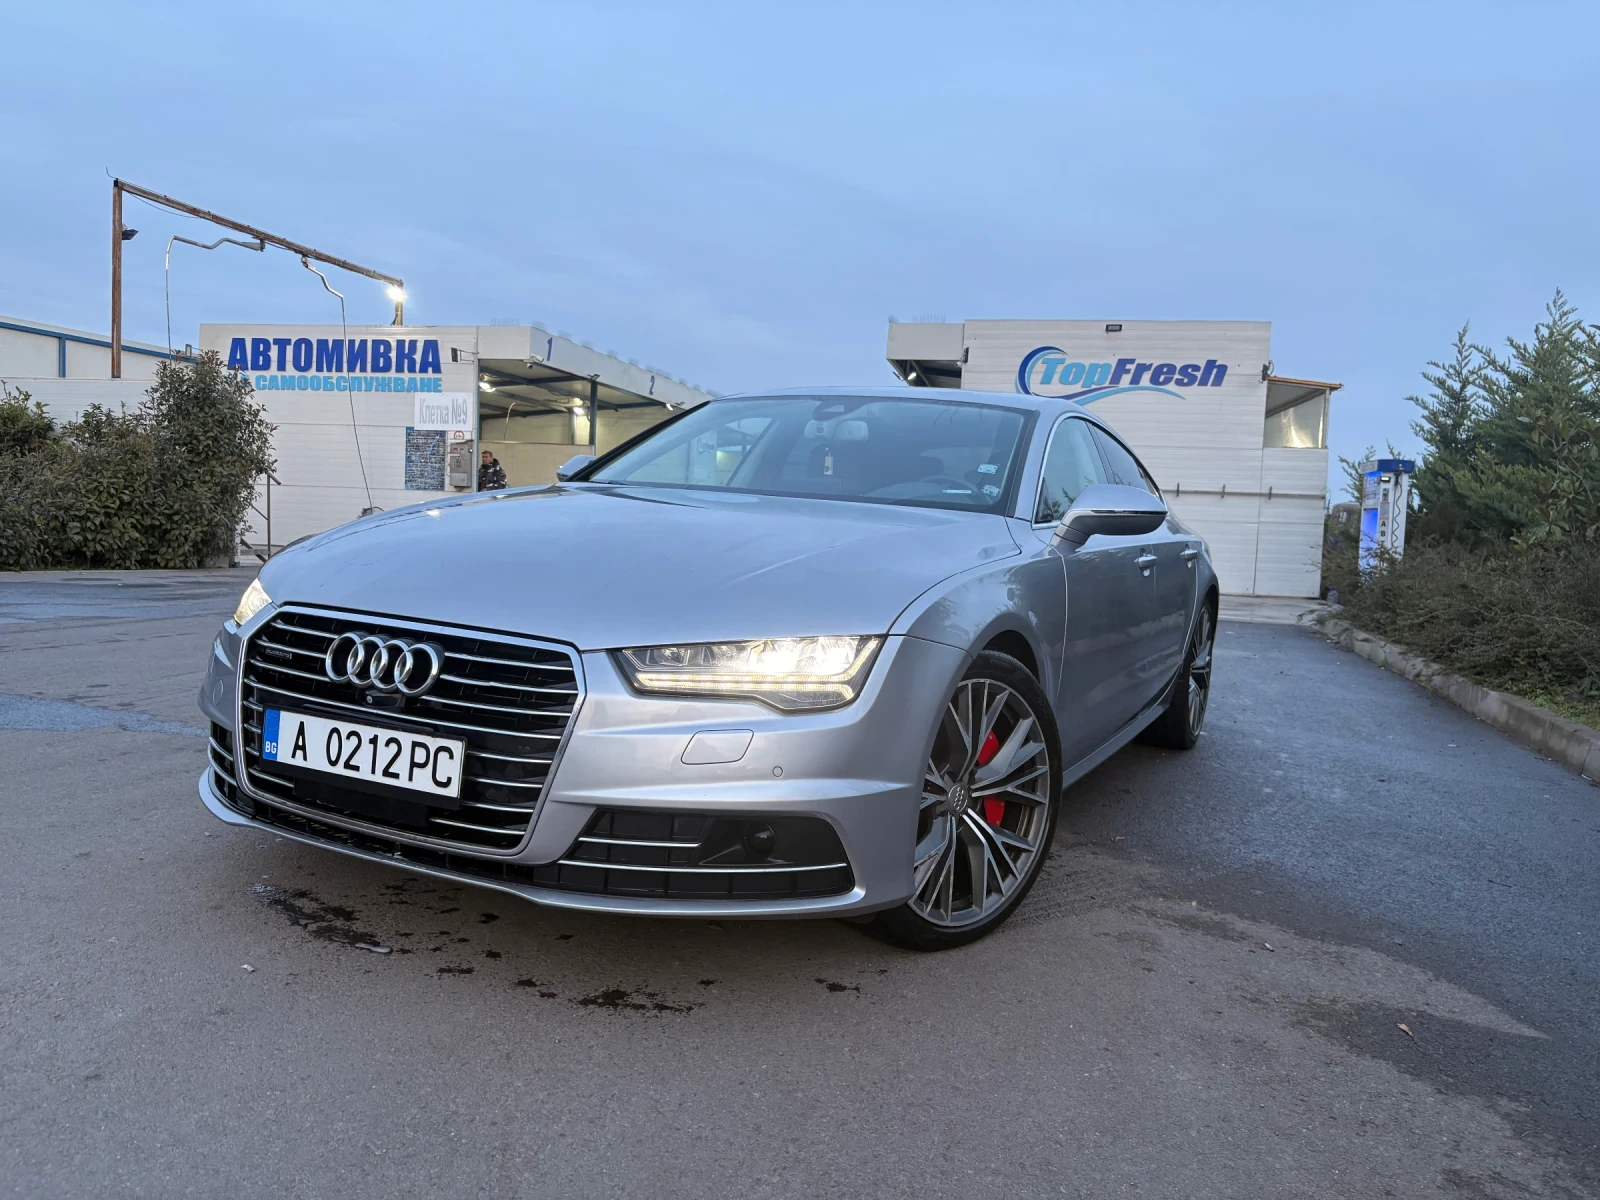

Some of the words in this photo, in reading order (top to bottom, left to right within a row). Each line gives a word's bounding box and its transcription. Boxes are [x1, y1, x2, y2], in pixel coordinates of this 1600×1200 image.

[227, 337, 442, 374] АВТОМИВКА
[547, 337, 553, 362] 1
[255, 375, 442, 393] САМООБСЛУЖВАНЕ
[648, 375, 655, 396] 2
[1040, 358, 1228, 388] TopFresh
[419, 399, 449, 424] Клетка
[451, 399, 468, 425] №9
[265, 741, 277, 754] BG
